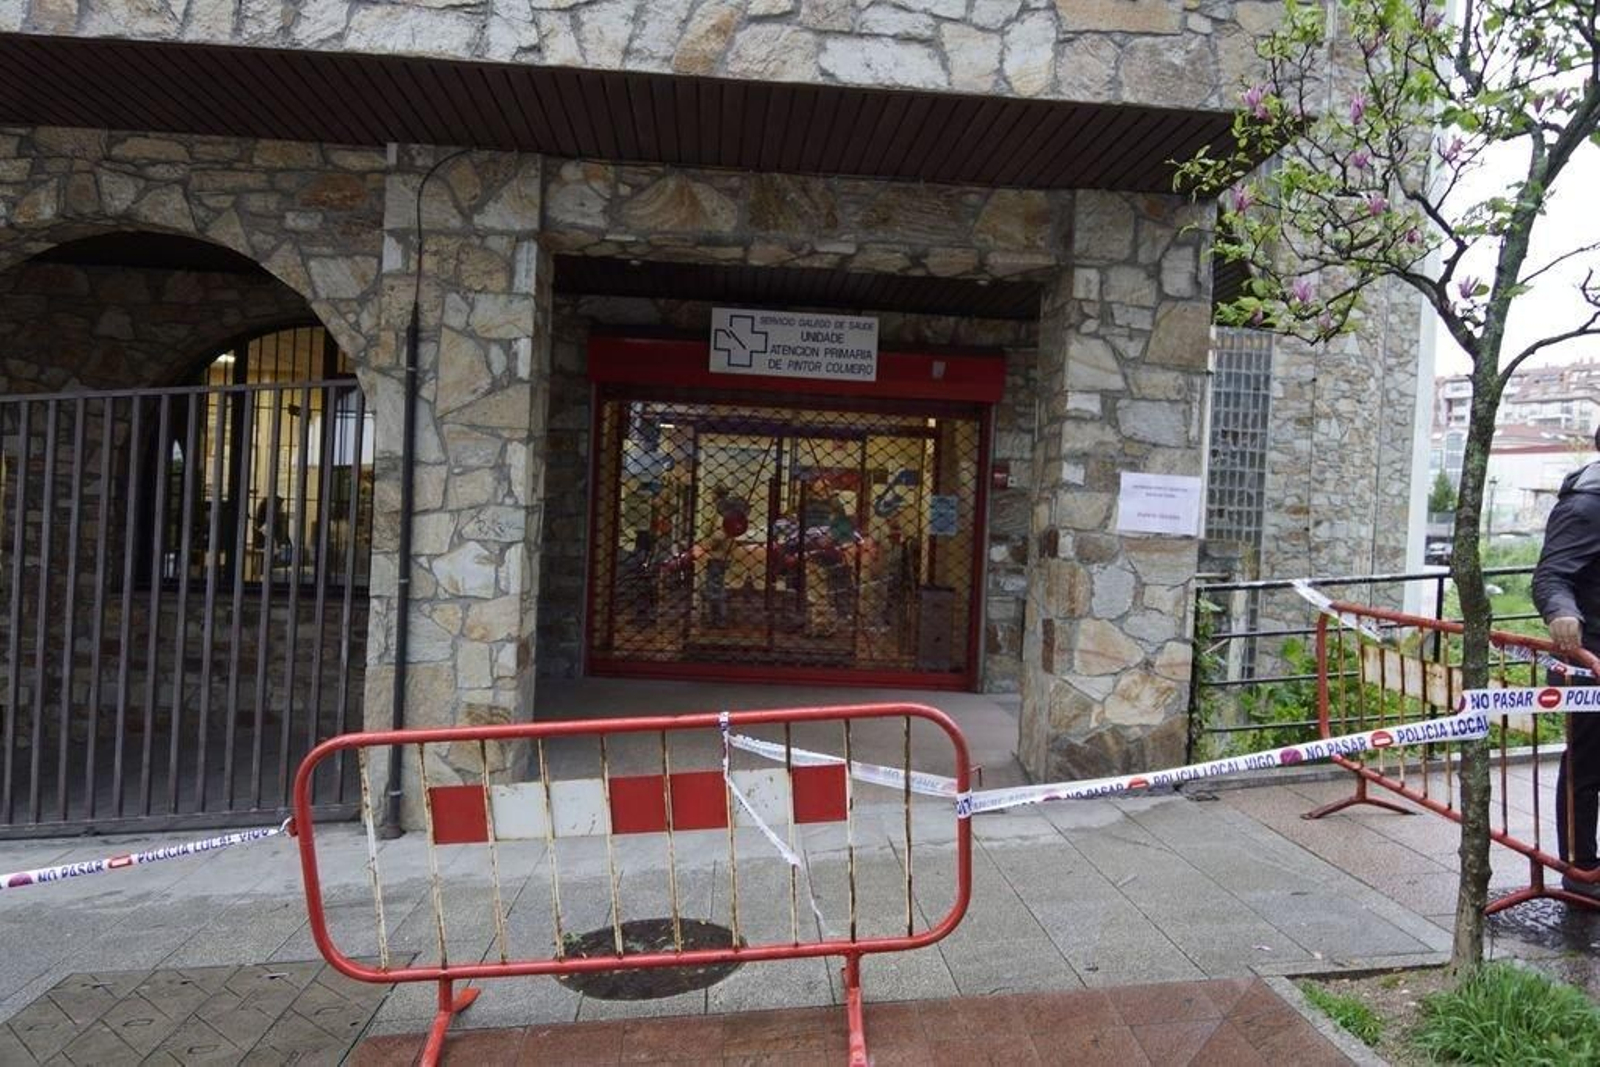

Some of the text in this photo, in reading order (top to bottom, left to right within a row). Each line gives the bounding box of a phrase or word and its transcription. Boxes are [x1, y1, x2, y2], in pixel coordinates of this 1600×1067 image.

[760, 316, 796, 327] SERVICIO
[834, 320, 845, 330] DE
[849, 321, 876, 332] SAUDE
[801, 331, 845, 344] UNIDADE
[824, 347, 873, 360] PRIMARIA
[767, 358, 782, 370] DE
[787, 360, 823, 372] PINTOR
[1470, 692, 1490, 710] NO
[1493, 690, 1534, 709] PASAR
[1244, 754, 1276, 770] VIGO
[1305, 744, 1324, 761] NO
[1327, 737, 1368, 756] PASAR
[1398, 722, 1446, 744] POLICIA
[38, 869, 58, 882] NO
[61, 860, 105, 879] PASAR
